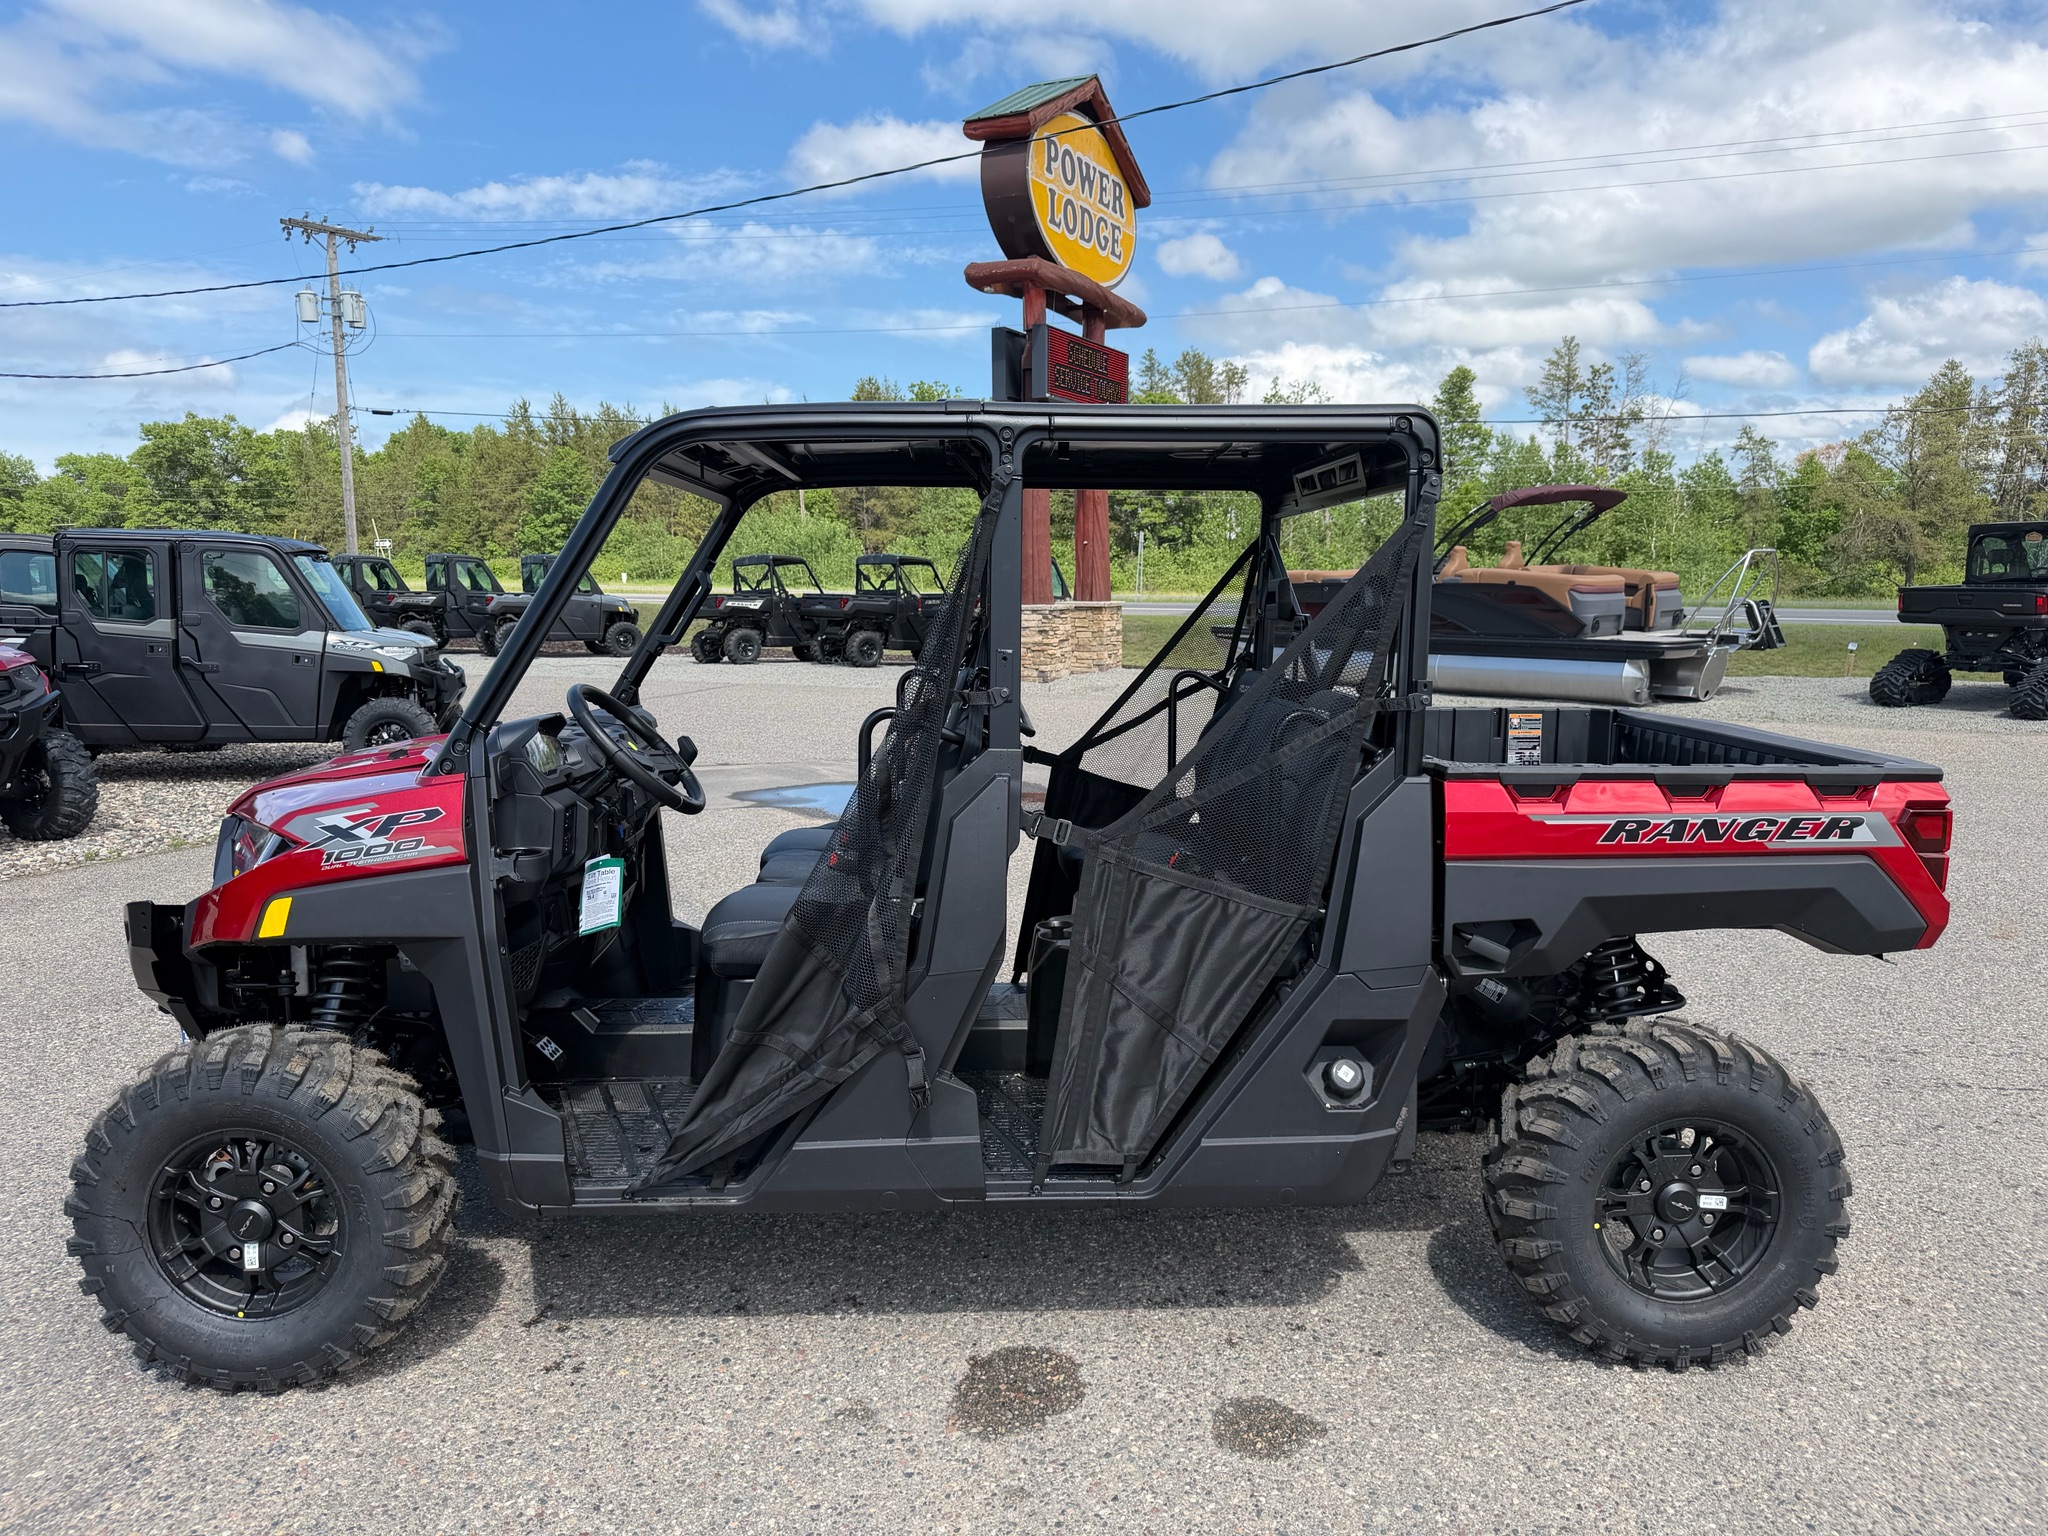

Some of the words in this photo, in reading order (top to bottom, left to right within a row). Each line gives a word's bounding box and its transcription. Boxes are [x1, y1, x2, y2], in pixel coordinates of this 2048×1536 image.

[1045, 135, 1125, 220] POWER
[1047, 187, 1123, 262] LODGE
[1068, 343, 1108, 374] SCHEDULE
[1054, 365, 1091, 394] SERVICE
[294, 807, 446, 853] XP
[1597, 816, 1866, 844] RANGER
[321, 837, 425, 866] 1000
[321, 863, 344, 871] DUAL
[346, 855, 396, 867] OVERHEAD
[396, 851, 418, 860] CAM
[597, 868, 616, 877] Table
